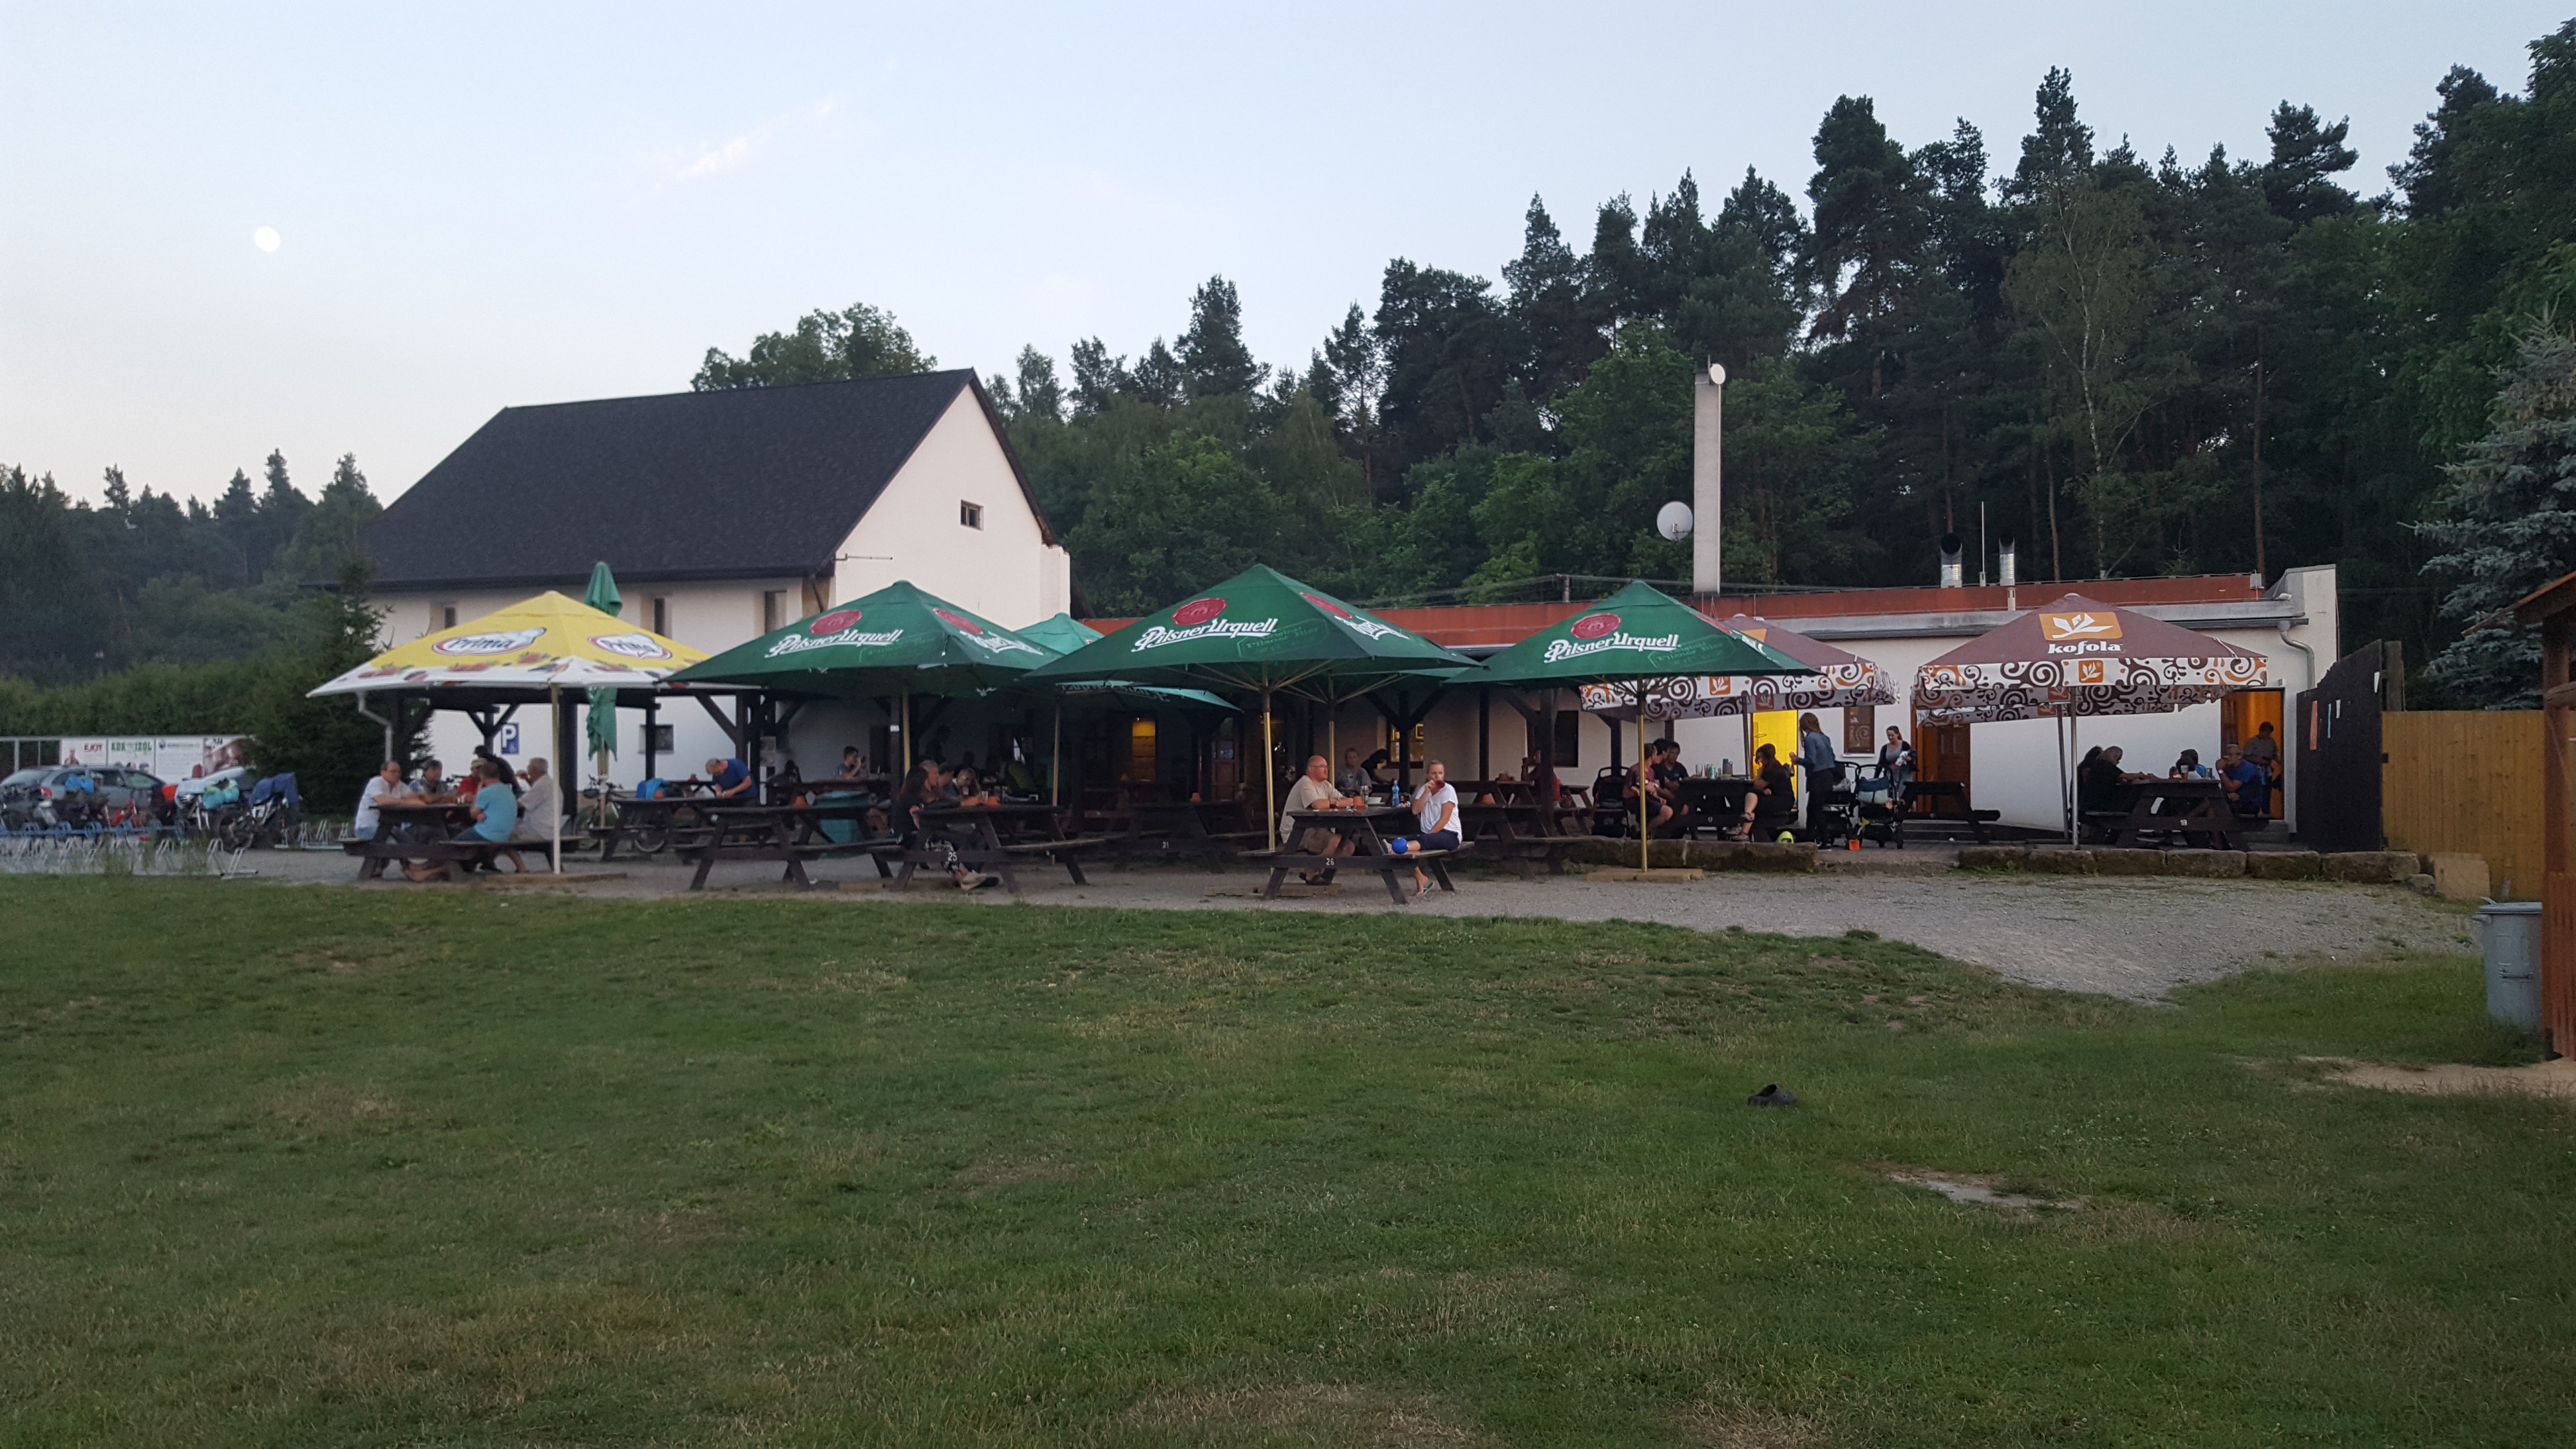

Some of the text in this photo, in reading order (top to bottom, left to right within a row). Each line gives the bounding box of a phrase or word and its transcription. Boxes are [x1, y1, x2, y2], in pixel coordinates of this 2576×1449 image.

[764, 629, 904, 658] Pilsner Urquell
[1132, 618, 1279, 652] Pilsner Urquell
[1544, 639, 1615, 663] Pilsner
[1611, 632, 1680, 652] Urquell
[2048, 641, 2121, 655] kofola
[502, 724, 516, 748] P
[945, 851, 958, 862] 25
[1325, 857, 1335, 866] 26
